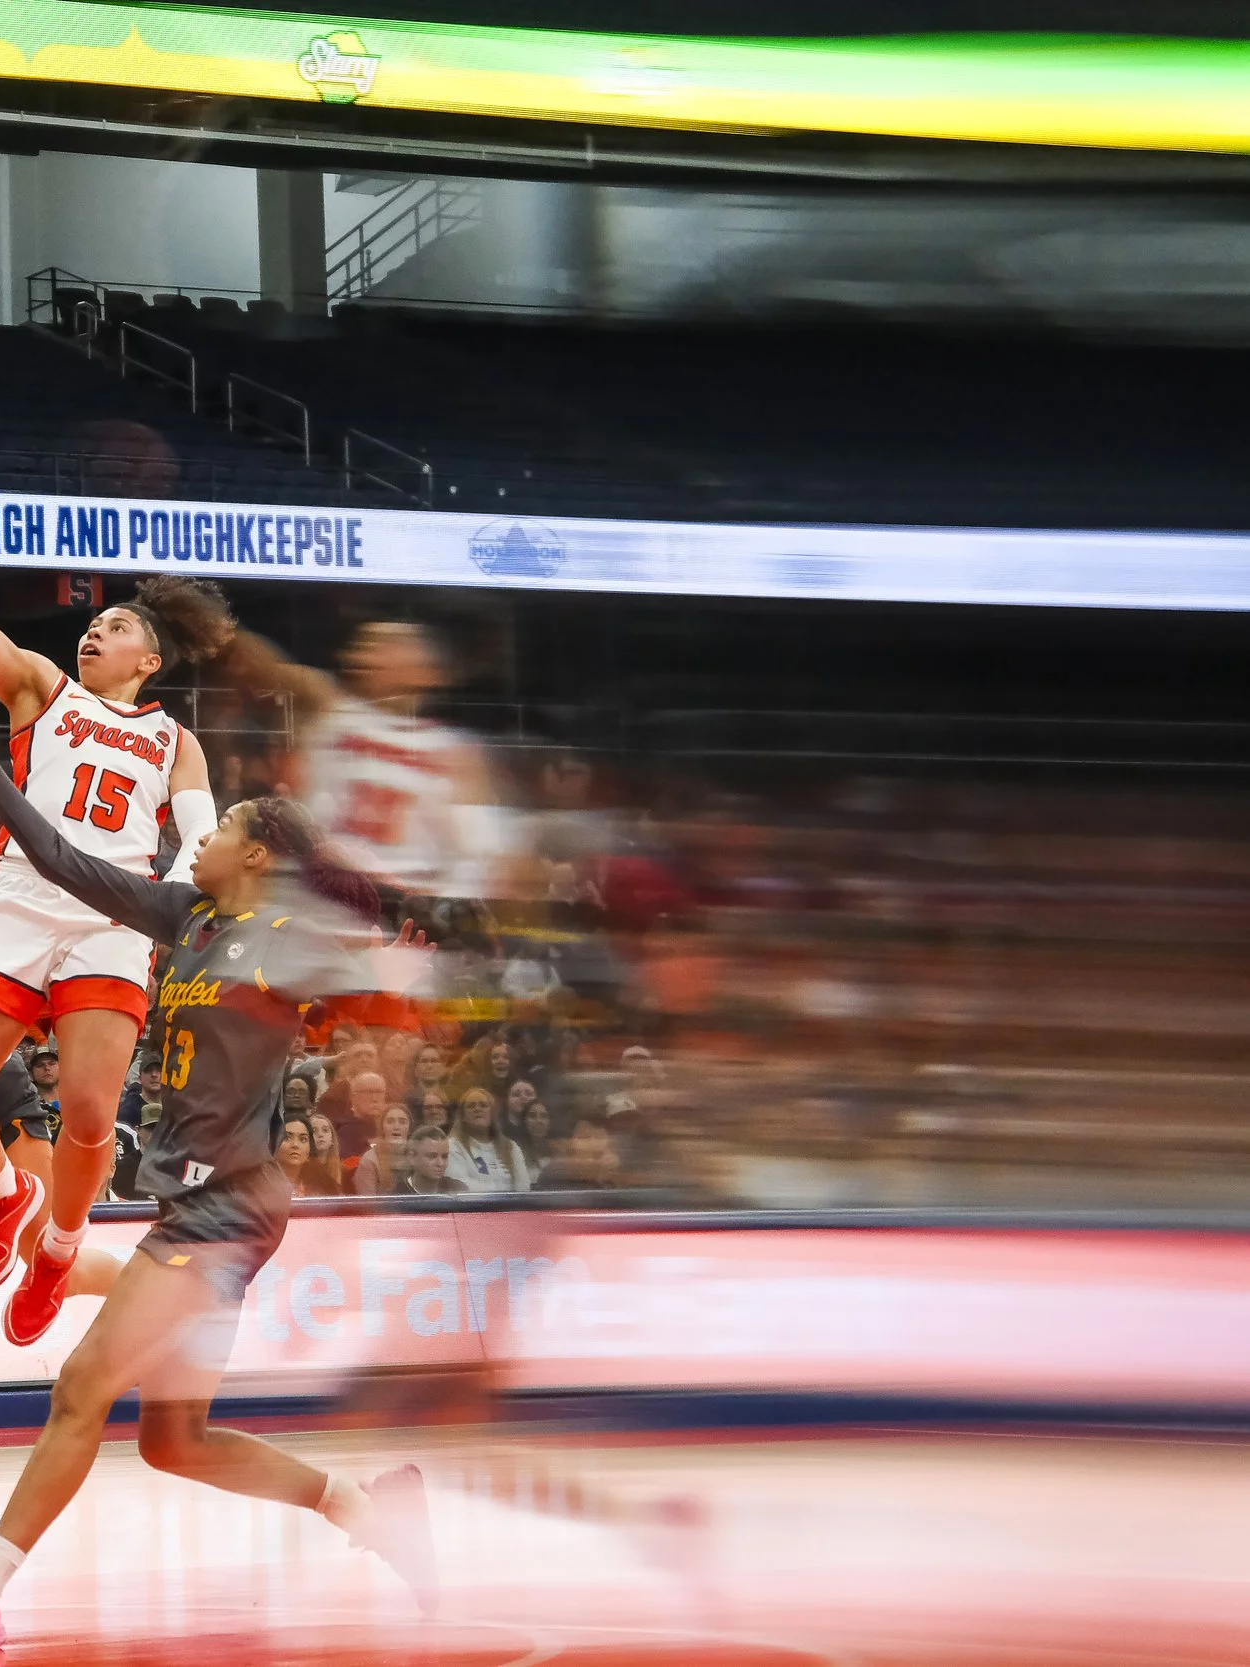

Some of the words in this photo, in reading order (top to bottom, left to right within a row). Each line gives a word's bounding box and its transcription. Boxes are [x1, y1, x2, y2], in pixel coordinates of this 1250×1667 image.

[55, 505, 120, 558] AND
[129, 508, 363, 567] POUGHKEEPSIE
[55, 711, 165, 771] Syracuse
[63, 763, 136, 832] 15
[161, 1026, 195, 1090] 13
